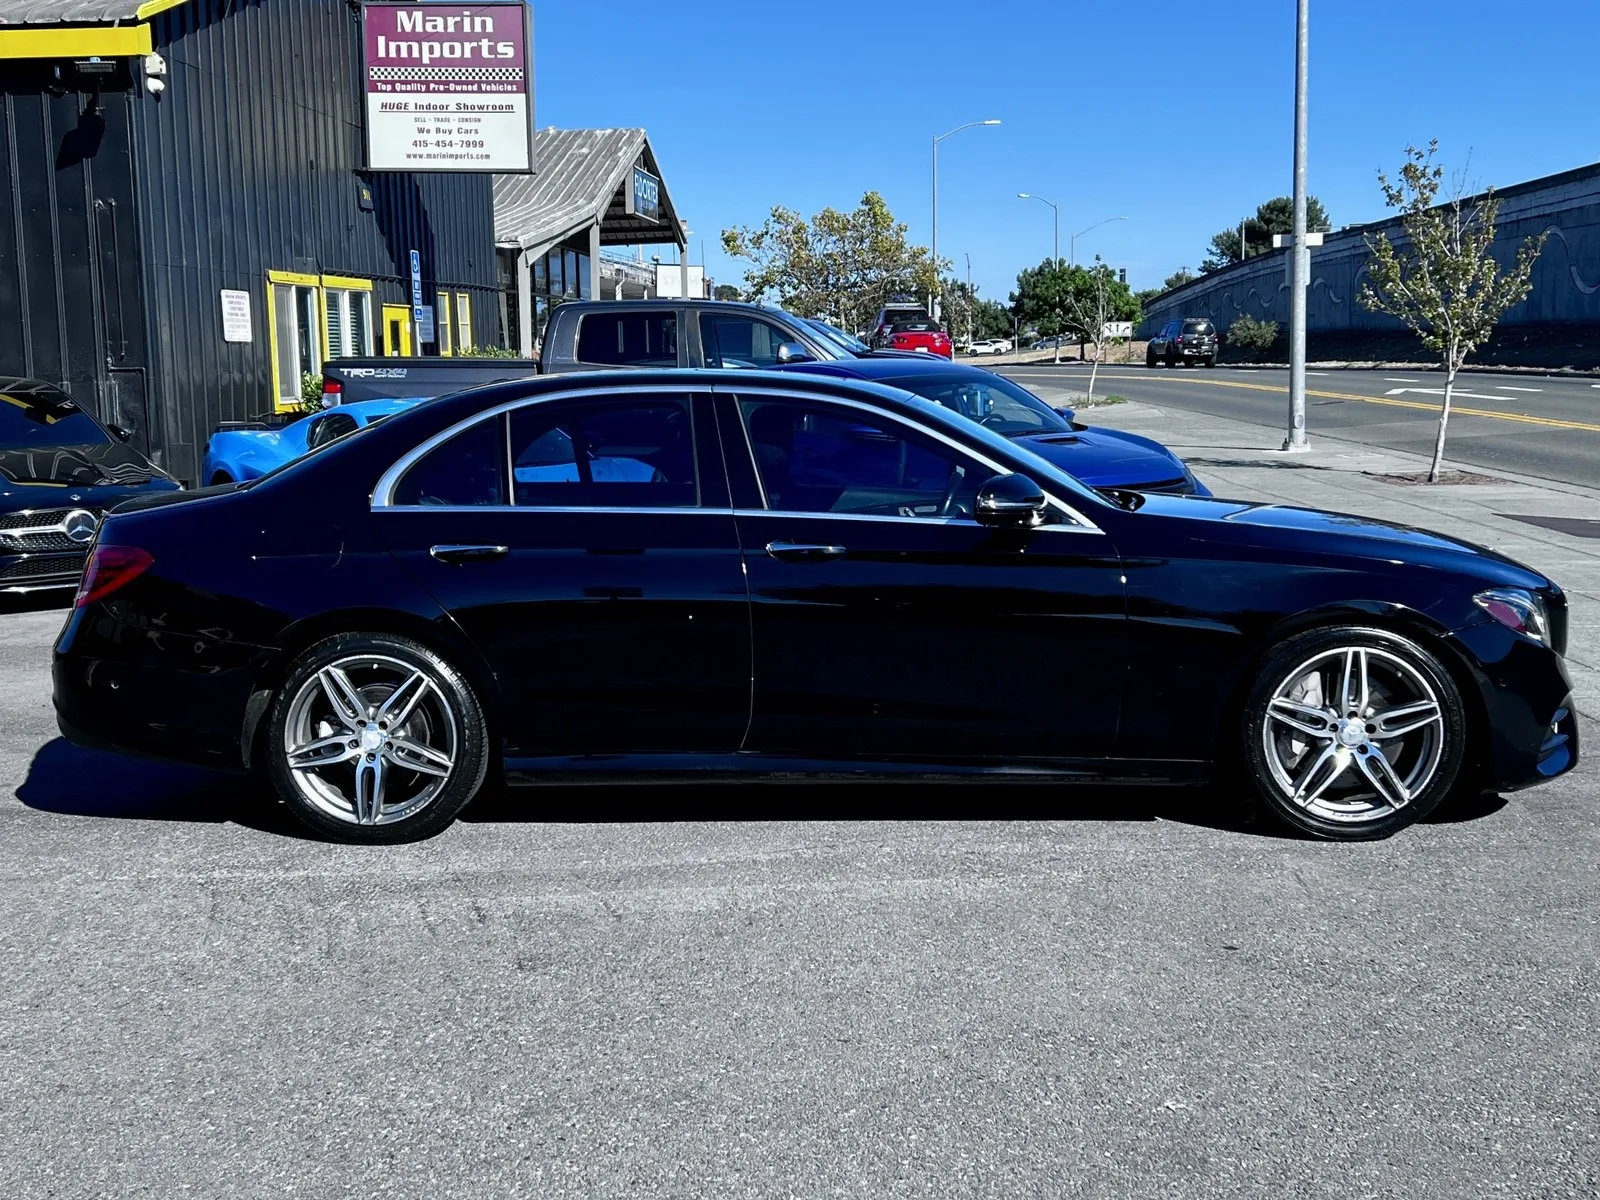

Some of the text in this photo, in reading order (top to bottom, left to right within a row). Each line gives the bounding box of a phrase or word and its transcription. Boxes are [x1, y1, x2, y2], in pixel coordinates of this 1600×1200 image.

[397, 11, 493, 33] Marin
[377, 36, 515, 64] Imports
[376, 82, 517, 92] Top Quality Pre-Owned Vehicles
[380, 102, 514, 111] HUGE Indoor Showroom
[417, 127, 479, 136] We Buy Cars
[412, 140, 484, 148] 415-454-7999
[405, 152, 491, 160] www.marinimports.com
